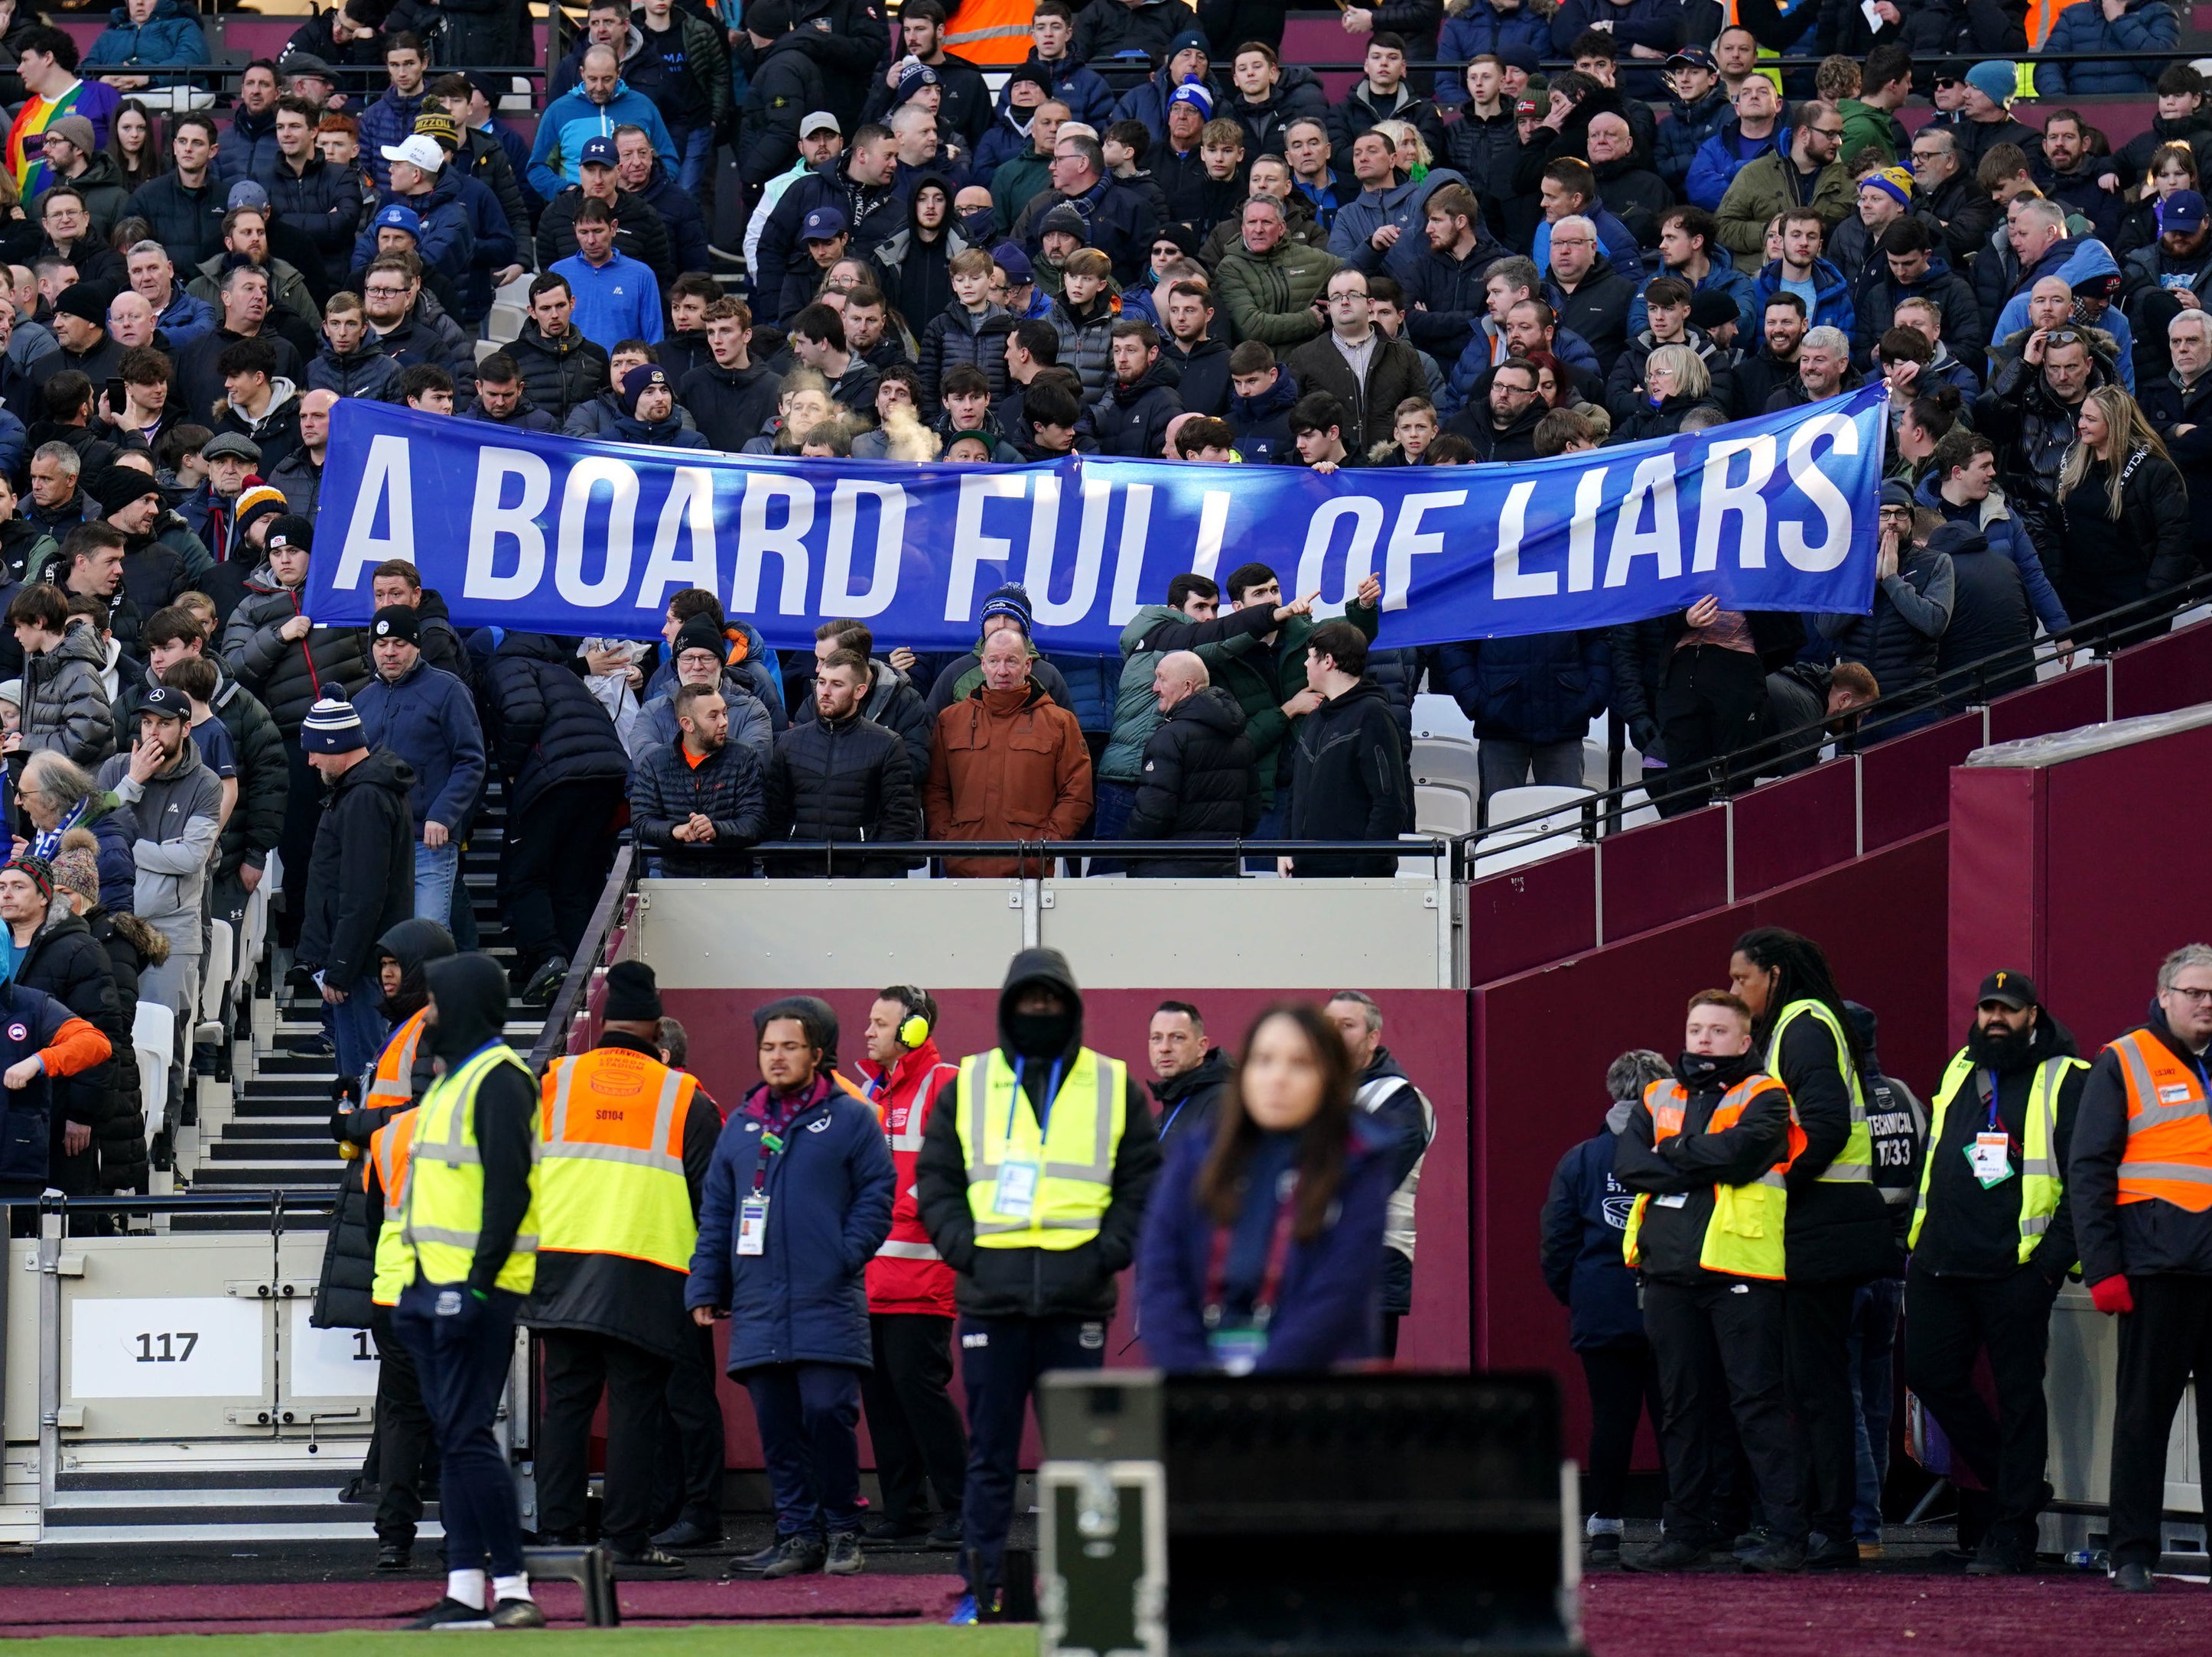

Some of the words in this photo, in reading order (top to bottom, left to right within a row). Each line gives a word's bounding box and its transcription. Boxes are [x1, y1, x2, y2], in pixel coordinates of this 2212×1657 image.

[332, 434, 415, 590] A
[463, 445, 908, 618] BOARD
[1296, 489, 1468, 623] OF
[1493, 413, 1859, 600] LIARS
[136, 1332, 199, 1362] 117
